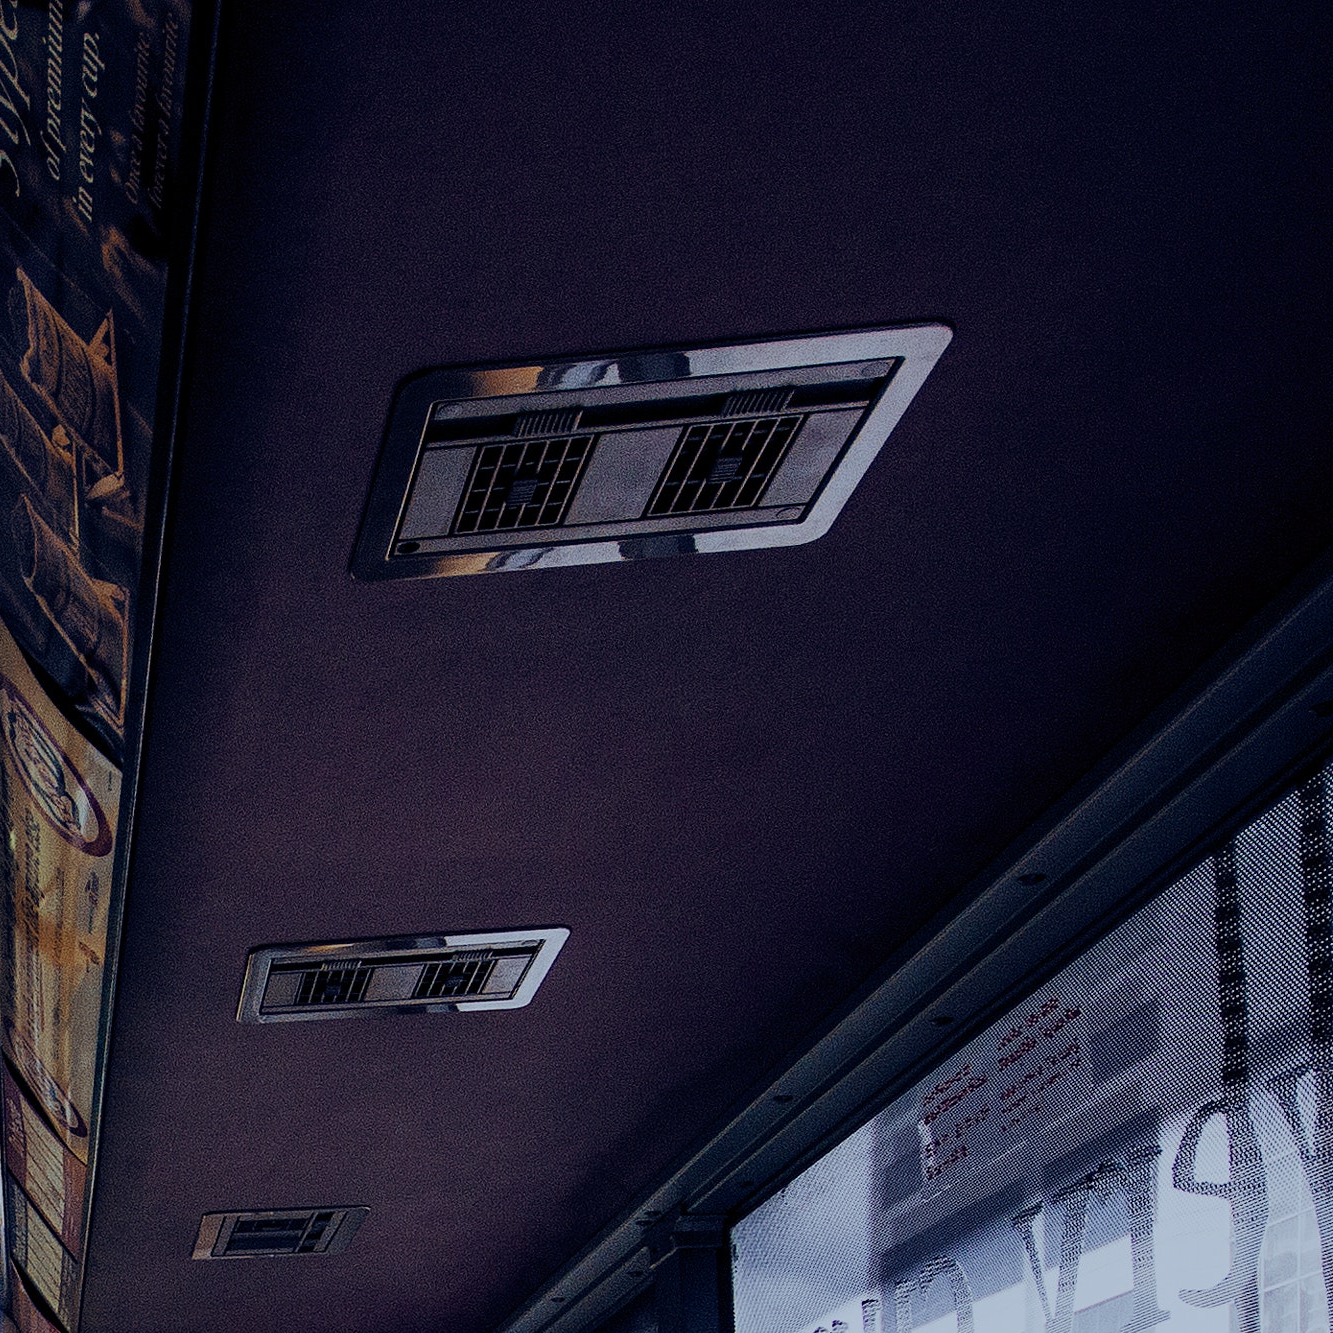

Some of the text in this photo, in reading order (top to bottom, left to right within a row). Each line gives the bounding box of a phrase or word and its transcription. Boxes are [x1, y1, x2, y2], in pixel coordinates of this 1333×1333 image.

[39, 129, 61, 182] of
[72, 31, 106, 223] in every cup.
